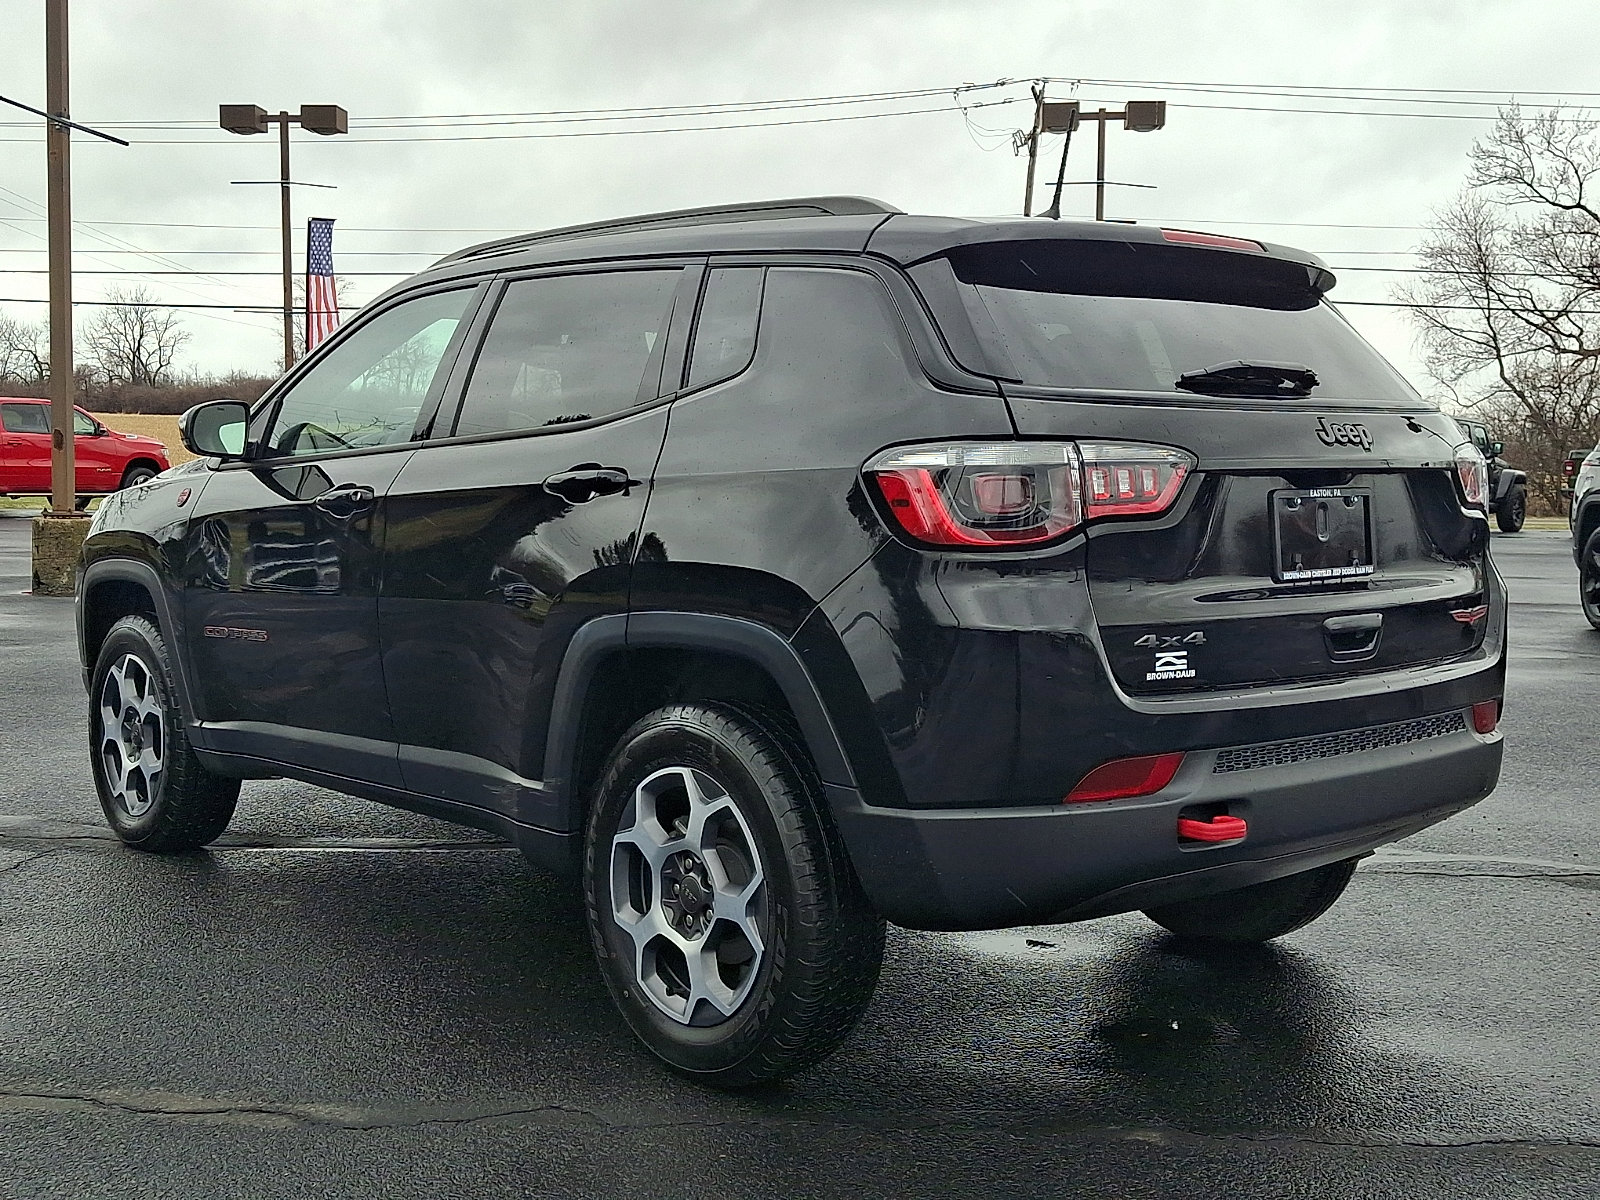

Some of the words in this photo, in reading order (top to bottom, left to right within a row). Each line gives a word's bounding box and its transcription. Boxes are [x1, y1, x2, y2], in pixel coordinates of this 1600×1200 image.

[1315, 416, 1374, 453] Jeep
[1309, 489, 1333, 498] EASTON,
[1333, 488, 1342, 497] PA
[1134, 631, 1207, 648] 4x4
[1146, 669, 1196, 681] BROWN-DAUB
